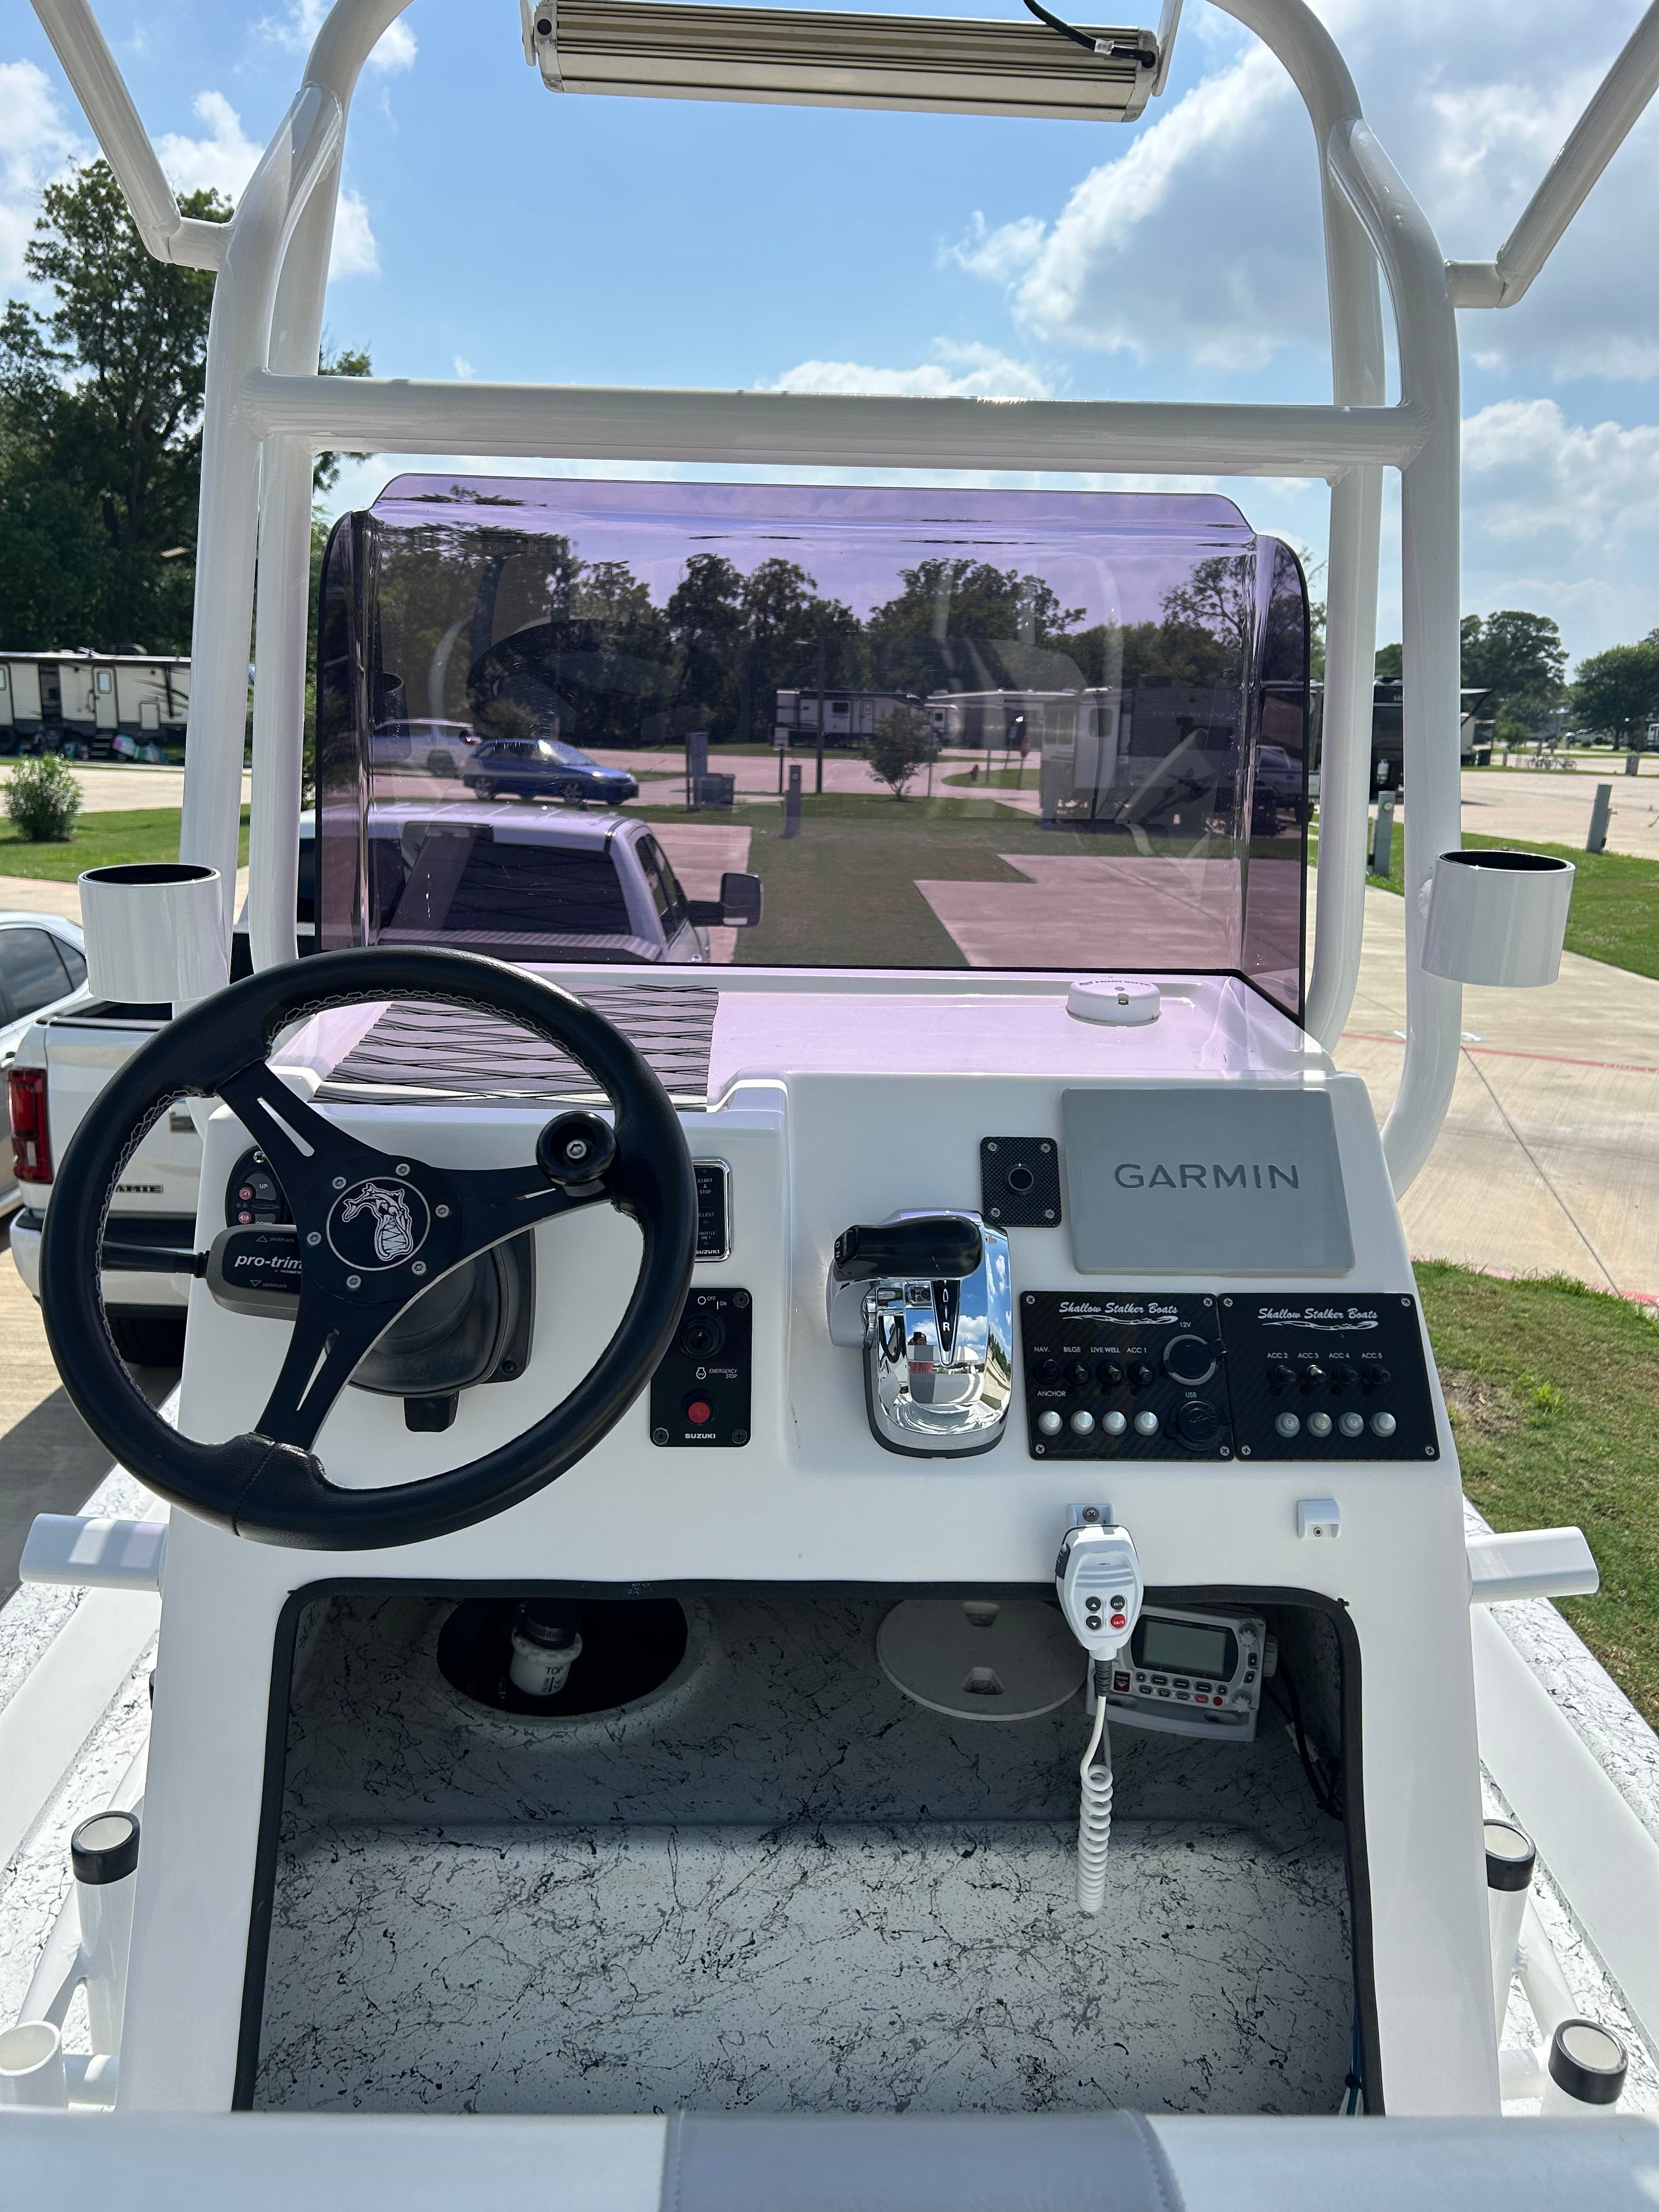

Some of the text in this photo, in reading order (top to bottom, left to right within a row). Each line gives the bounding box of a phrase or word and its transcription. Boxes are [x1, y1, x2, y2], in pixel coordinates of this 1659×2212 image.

[1115, 1164, 1299, 1189] GARMIN
[234, 1255, 302, 1269] pro-trim
[1059, 1302, 1178, 1313] Shallow Stalker Boats
[1258, 1308, 1378, 1319] Shallow Stalker Boats
[943, 1322, 951, 1331] R
[546, 1666, 564, 1675] TOP
